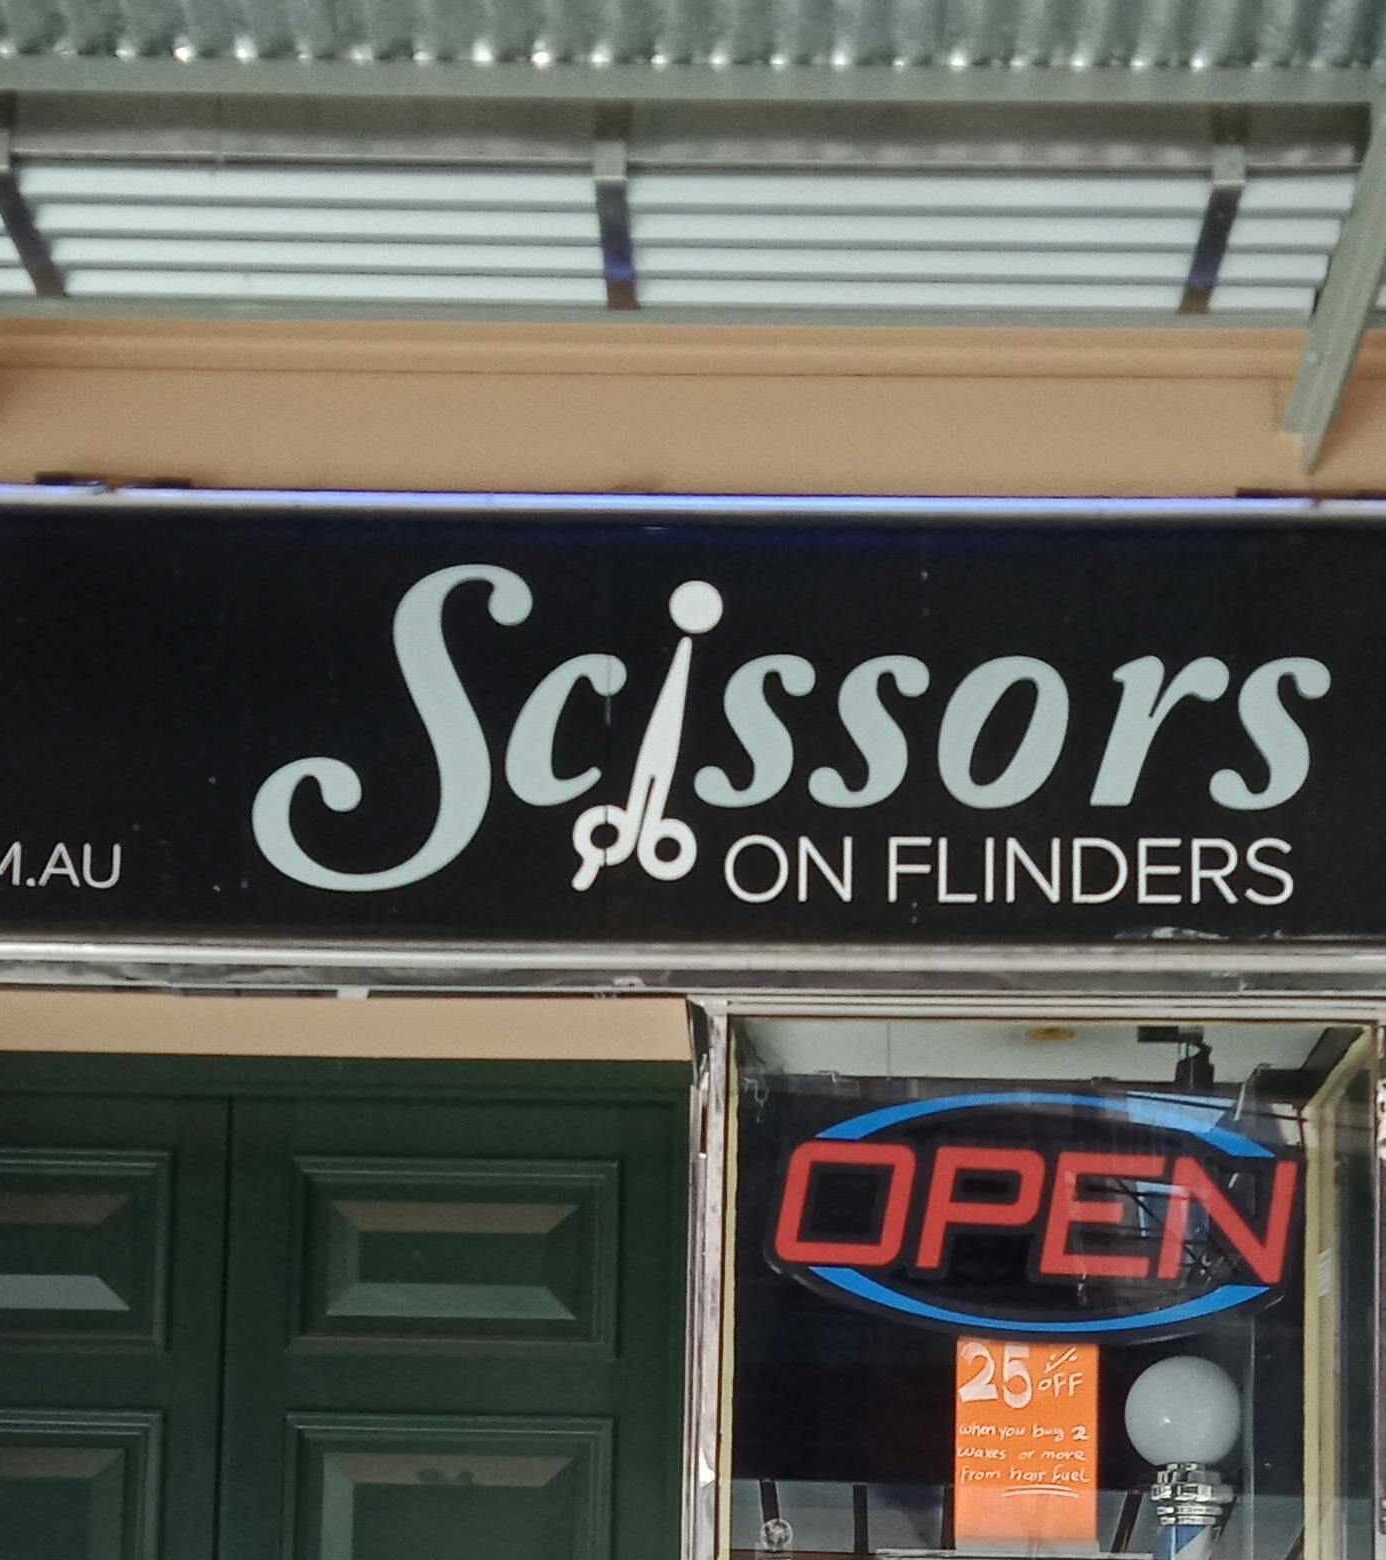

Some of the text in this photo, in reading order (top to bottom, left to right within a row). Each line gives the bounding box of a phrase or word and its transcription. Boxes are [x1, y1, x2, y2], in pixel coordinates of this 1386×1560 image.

[253, 564, 1331, 892] Scissors
[723, 833, 1295, 906] ON FLINDERS
[773, 1139, 1300, 1285] OPEN
[958, 1341, 1033, 1409] 25
[959, 1422, 996, 1438] when
[999, 1426, 1027, 1441] you
[1032, 1423, 1065, 1442] buy
[1018, 1450, 1034, 1460] or
[1041, 1450, 1087, 1462] more
